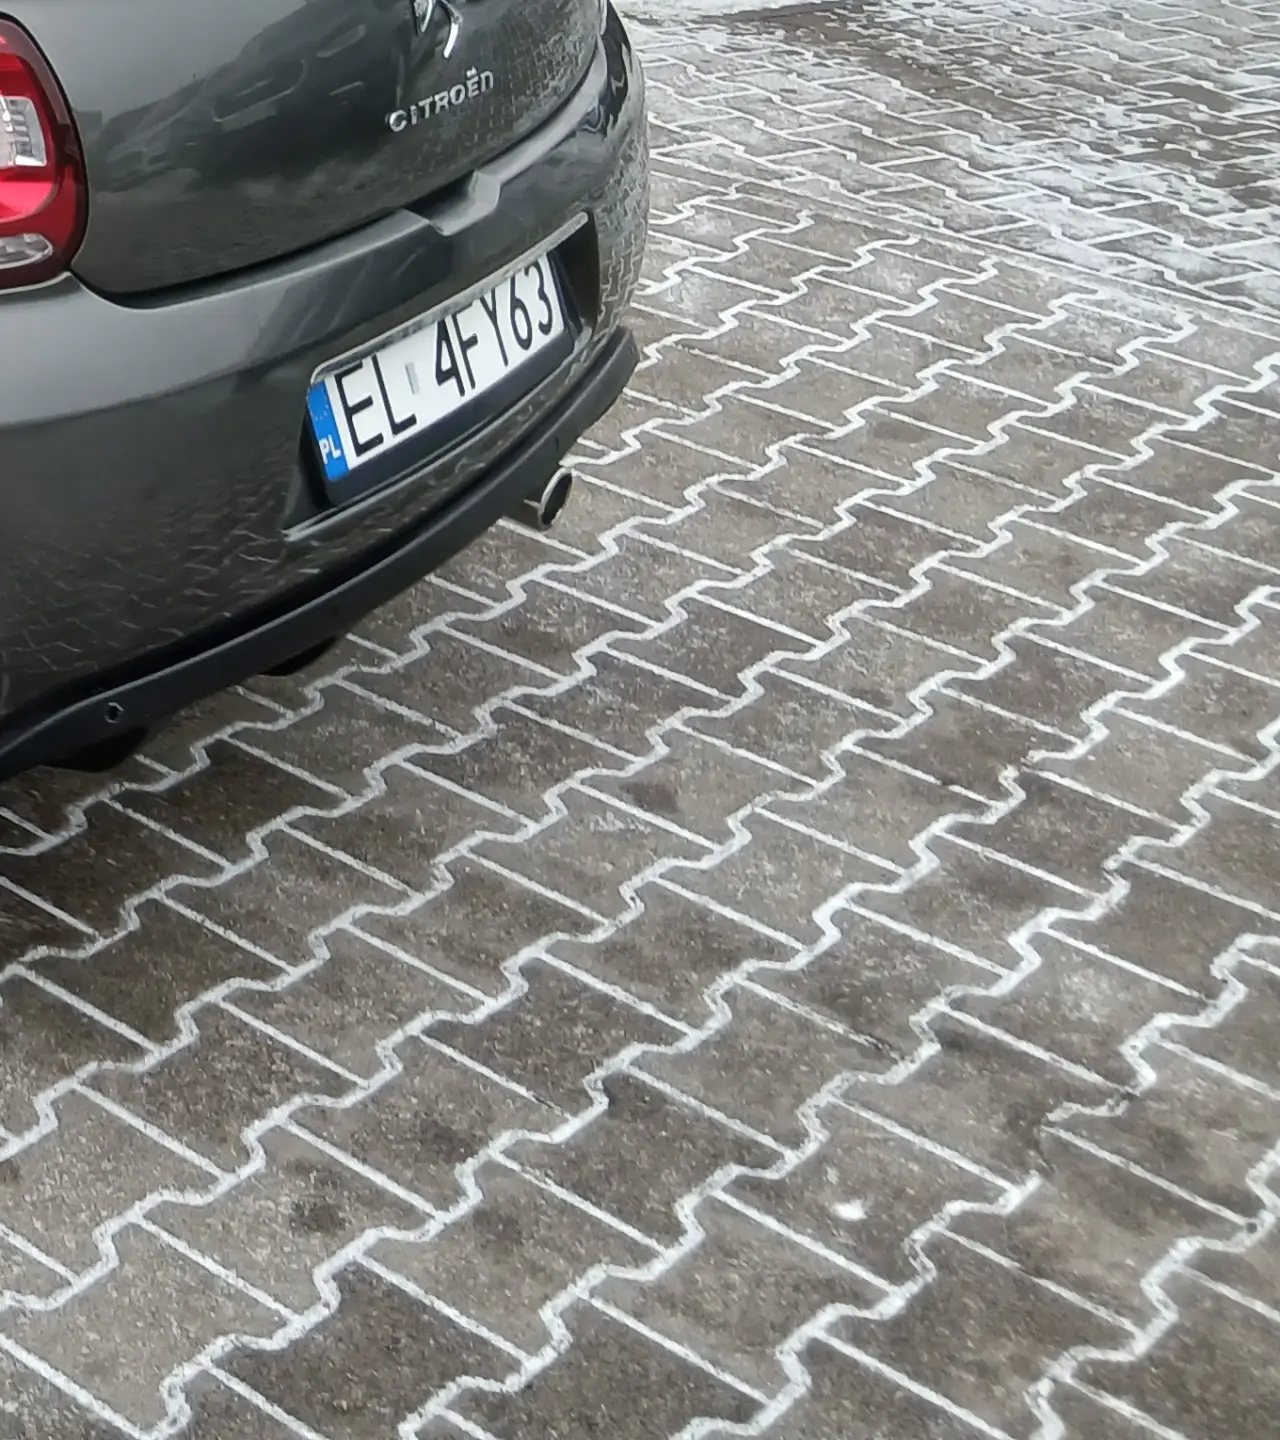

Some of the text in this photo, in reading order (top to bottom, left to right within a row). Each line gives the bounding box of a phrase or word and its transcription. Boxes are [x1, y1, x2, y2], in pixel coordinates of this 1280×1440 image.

[388, 66, 495, 133] CITROËN
[333, 259, 554, 458] EL 4FY63
[318, 436, 342, 465] PL
